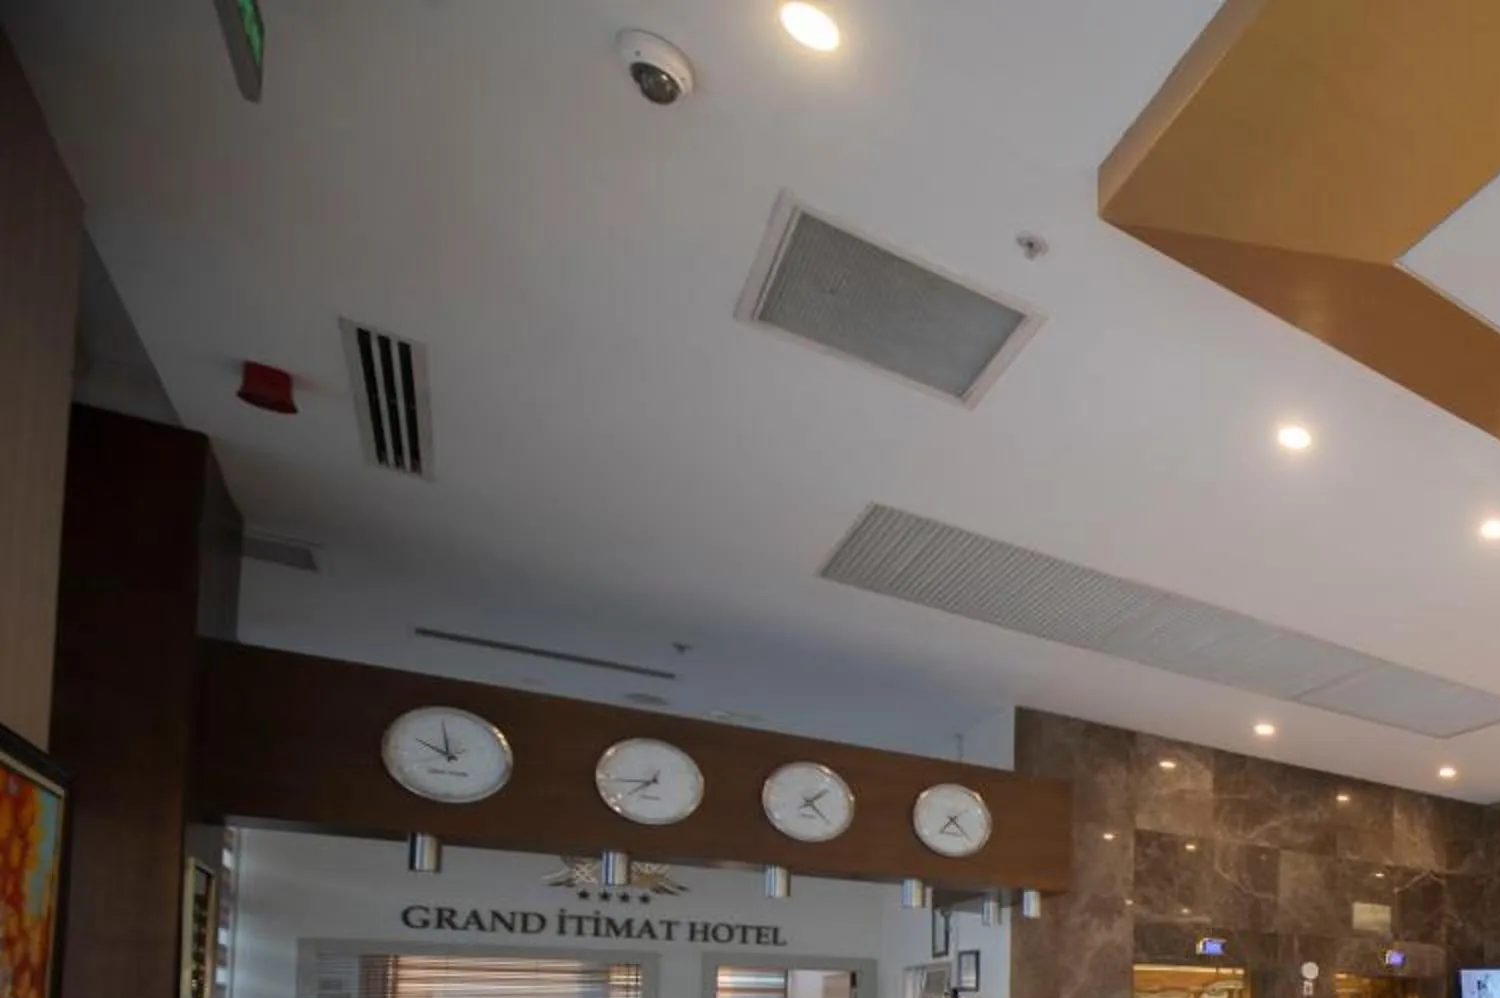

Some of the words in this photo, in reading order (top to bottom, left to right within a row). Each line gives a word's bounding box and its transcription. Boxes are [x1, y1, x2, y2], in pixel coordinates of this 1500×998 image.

[401, 904, 548, 935] GRAND
[556, 907, 681, 942] İTİMAT
[688, 920, 788, 947] HOTEL
